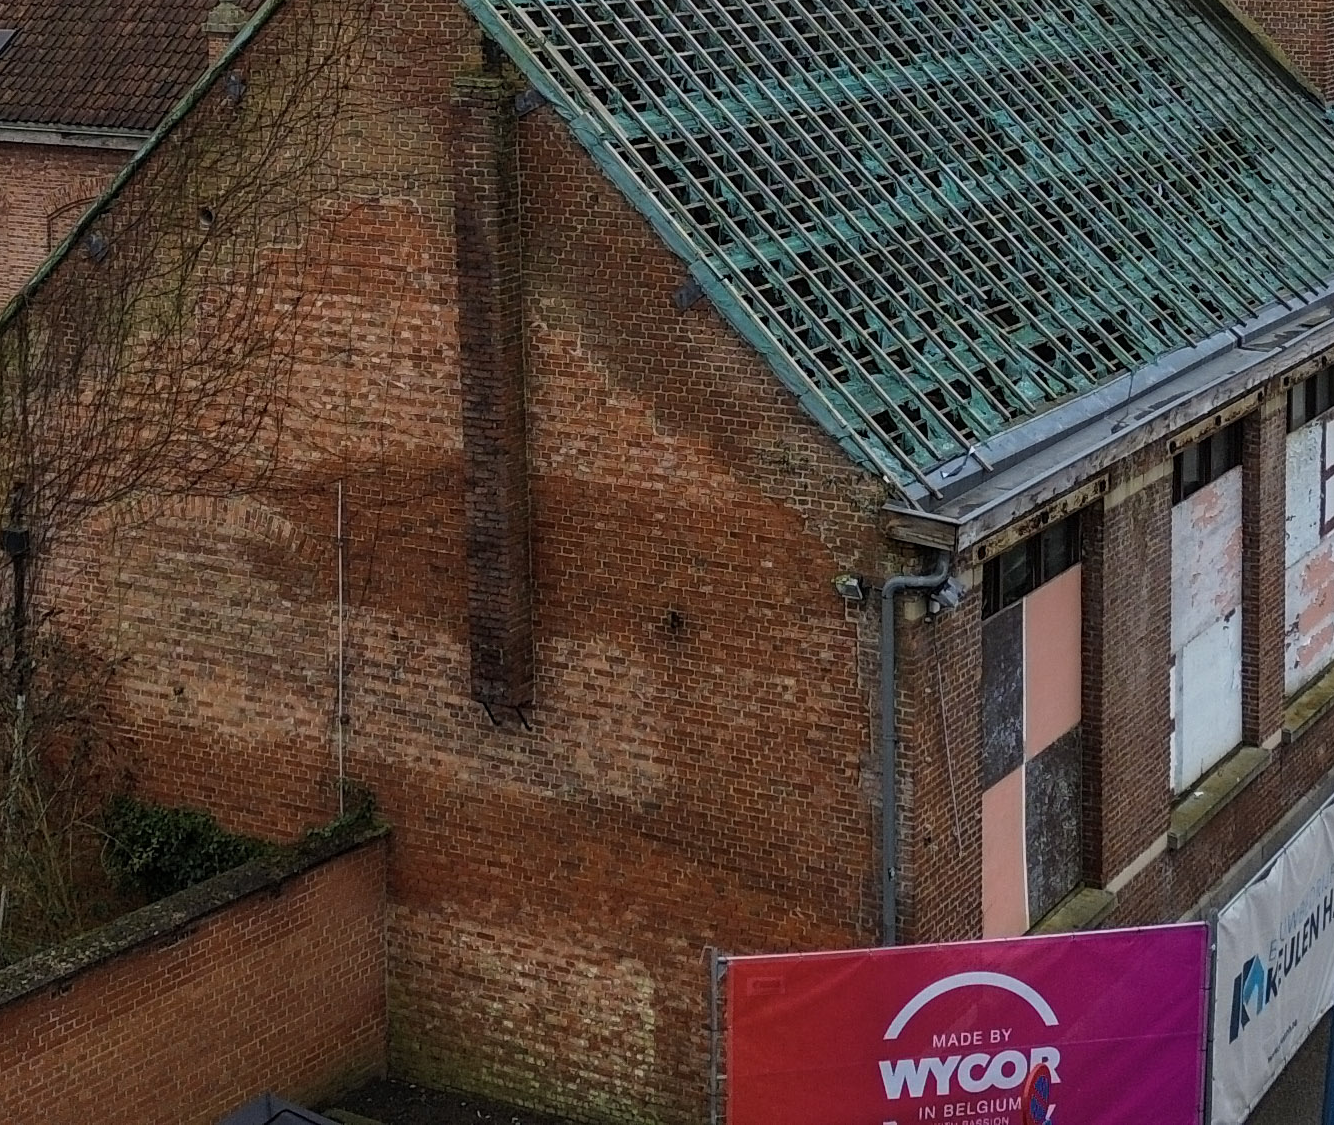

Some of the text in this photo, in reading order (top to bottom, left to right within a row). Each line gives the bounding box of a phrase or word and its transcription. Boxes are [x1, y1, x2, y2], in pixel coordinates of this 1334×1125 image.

[932, 1028, 1013, 1048] MADE BY
[878, 1046, 1062, 1100] WYCOR
[918, 1106, 936, 1121] IN
[943, 1096, 1023, 1118] BELGIUM
